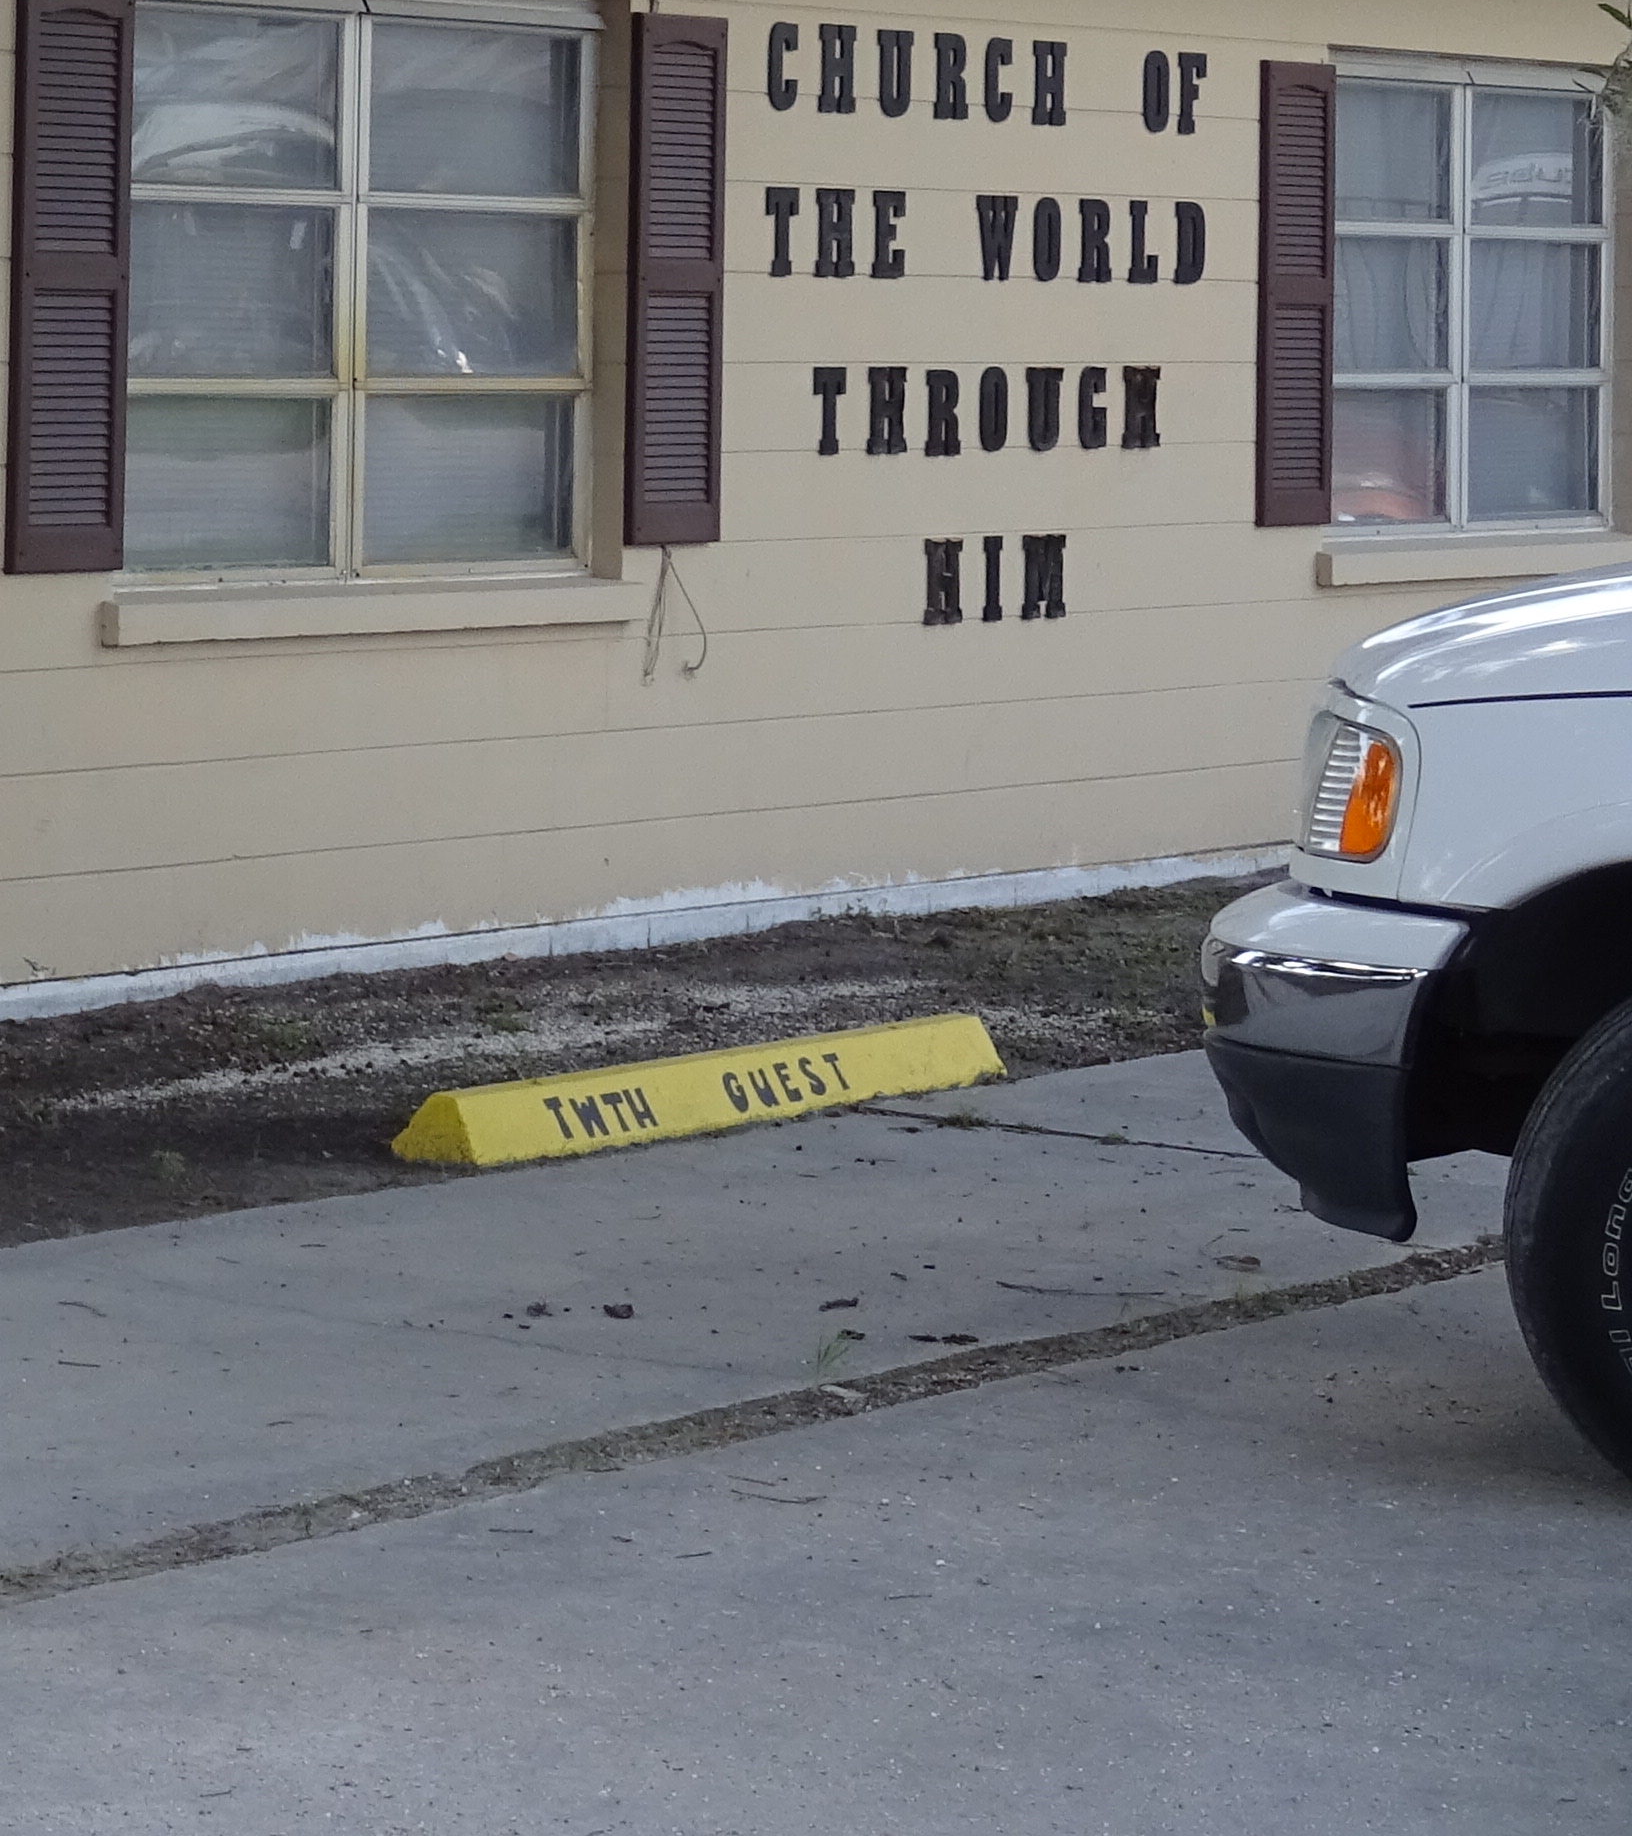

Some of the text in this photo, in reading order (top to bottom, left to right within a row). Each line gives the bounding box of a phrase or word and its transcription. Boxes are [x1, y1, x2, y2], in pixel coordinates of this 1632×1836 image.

[767, 21, 1208, 135] CHURCH OF
[765, 186, 1206, 285] THE WORLD
[813, 365, 1162, 457] THROUGH
[923, 533, 1068, 626] HIM
[543, 1051, 851, 1140] TWTH GUEST
